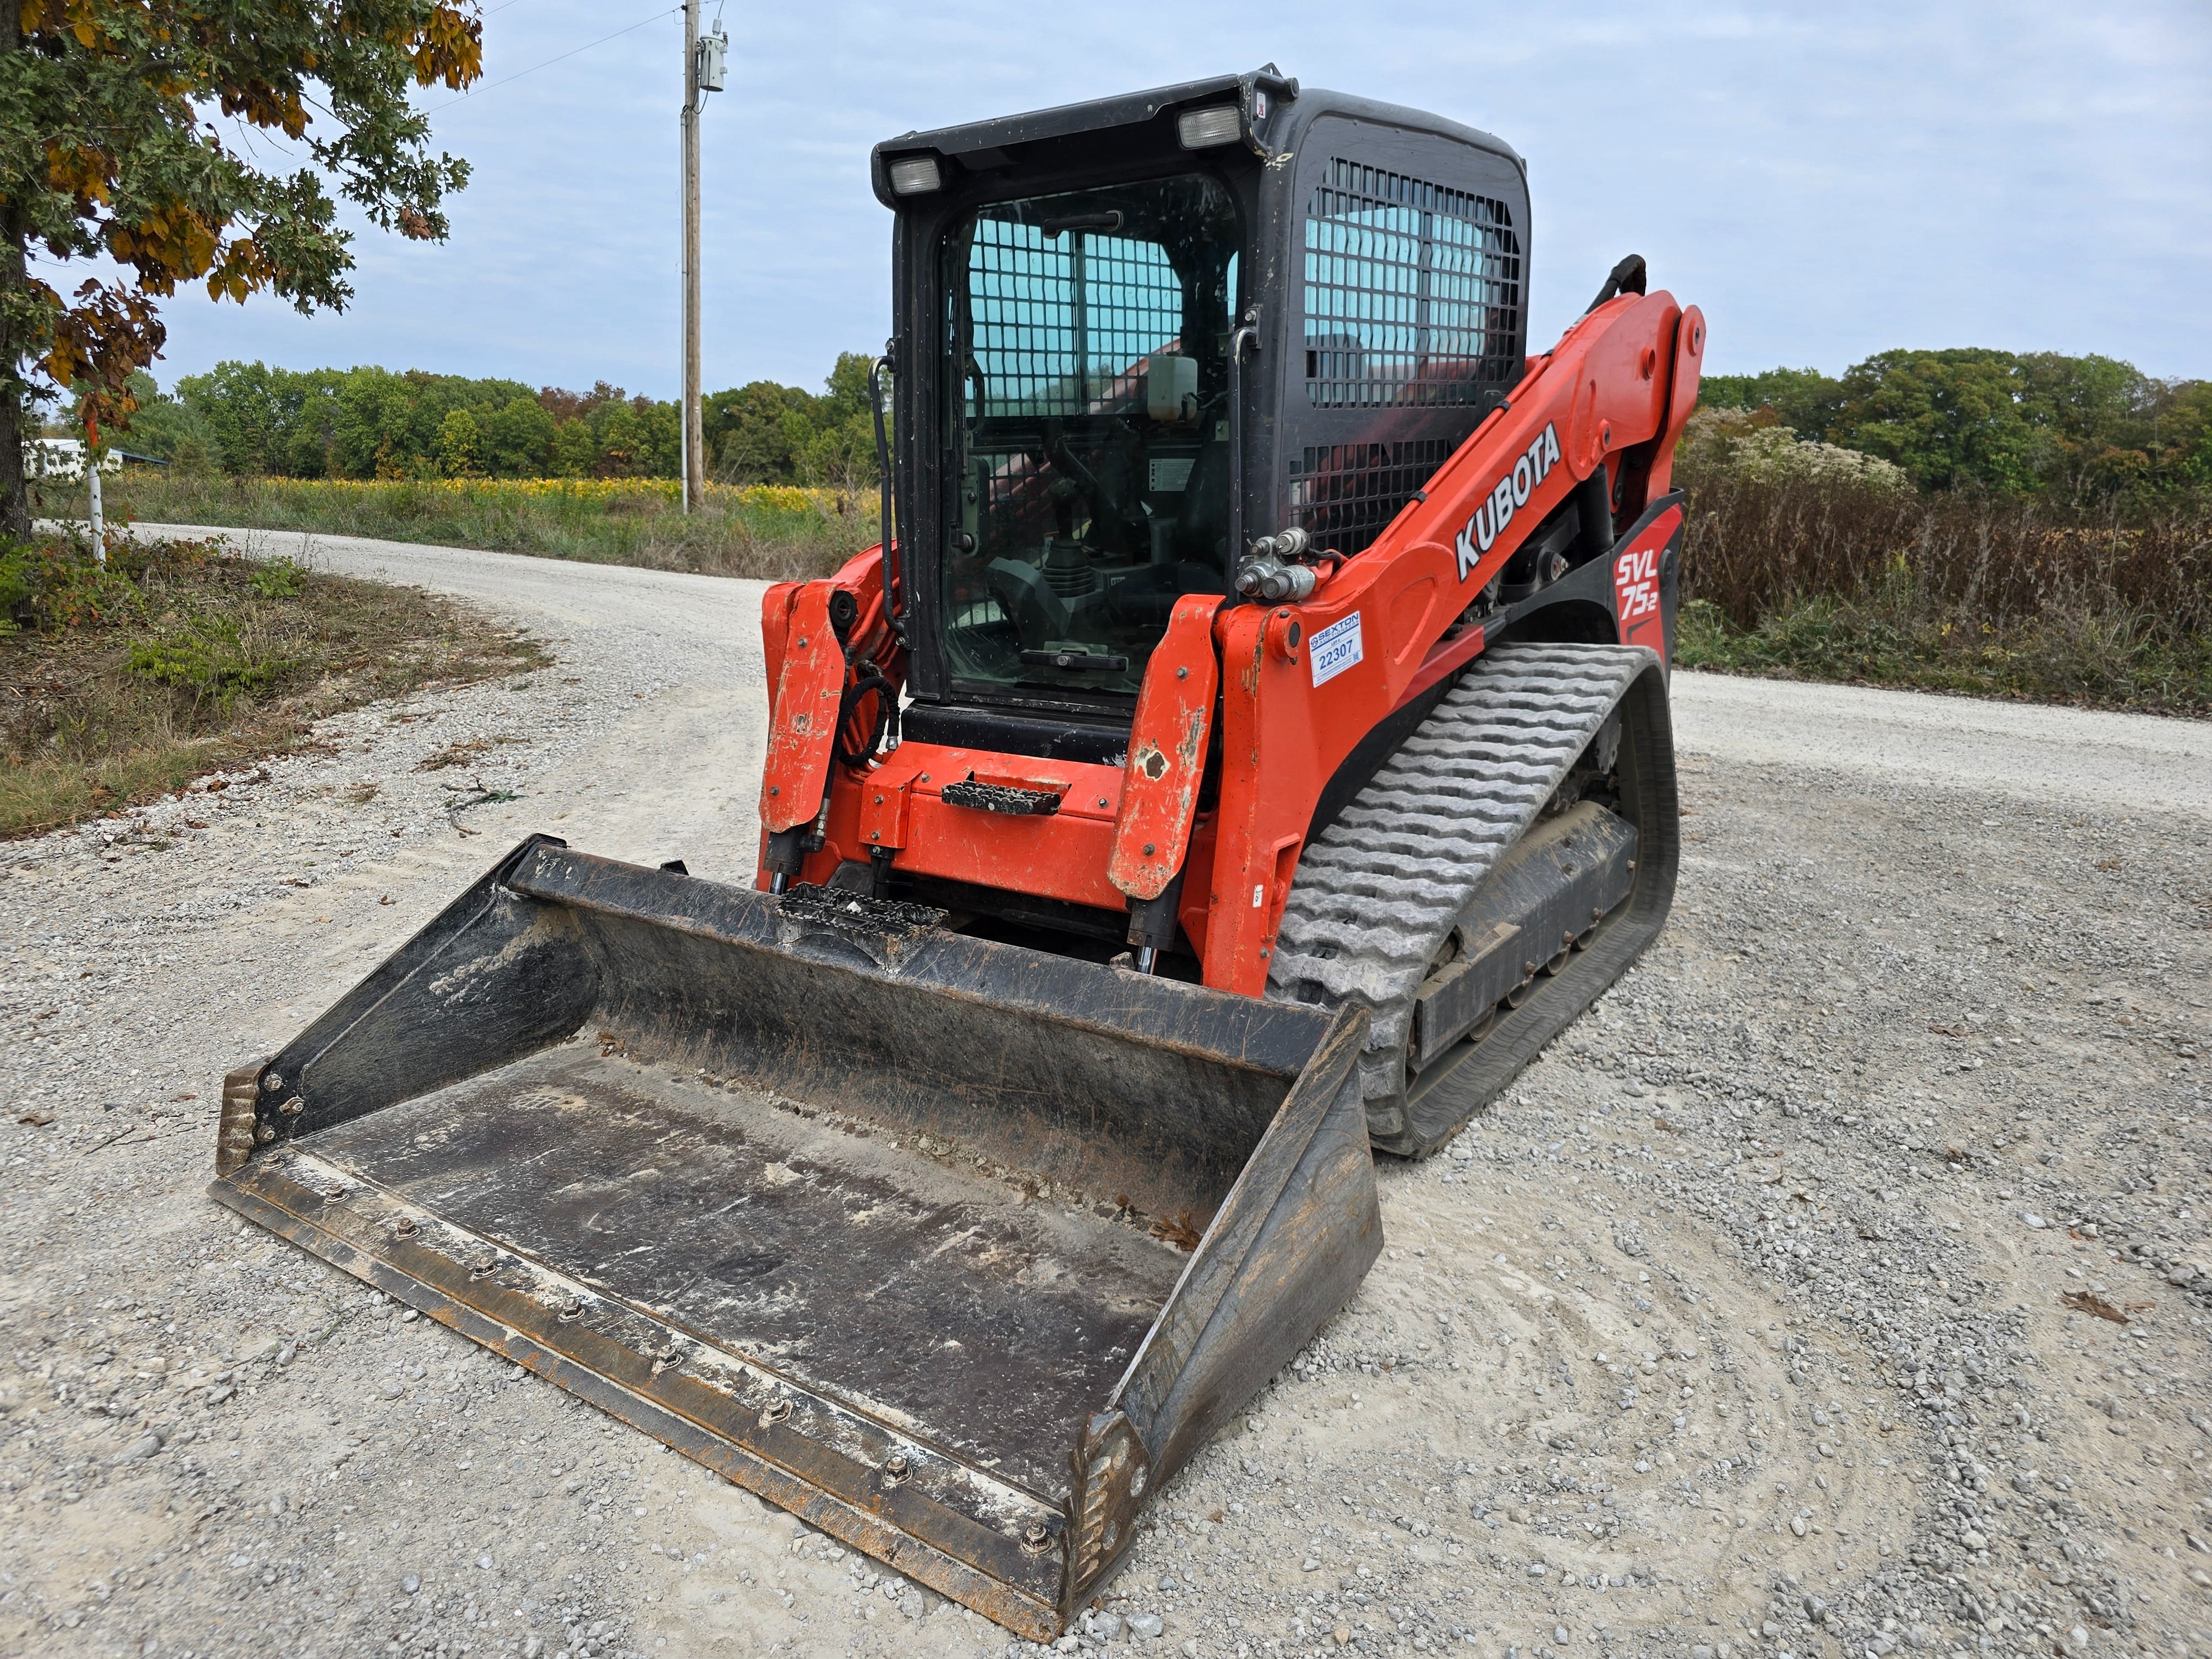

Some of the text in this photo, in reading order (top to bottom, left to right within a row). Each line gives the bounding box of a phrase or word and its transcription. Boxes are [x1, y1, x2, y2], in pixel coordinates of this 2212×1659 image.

[1456, 421, 1559, 582] KUBOTA
[1616, 549, 1657, 586] SVL
[1318, 613, 1358, 640] SEXTON
[1319, 639, 1353, 670] 22307
